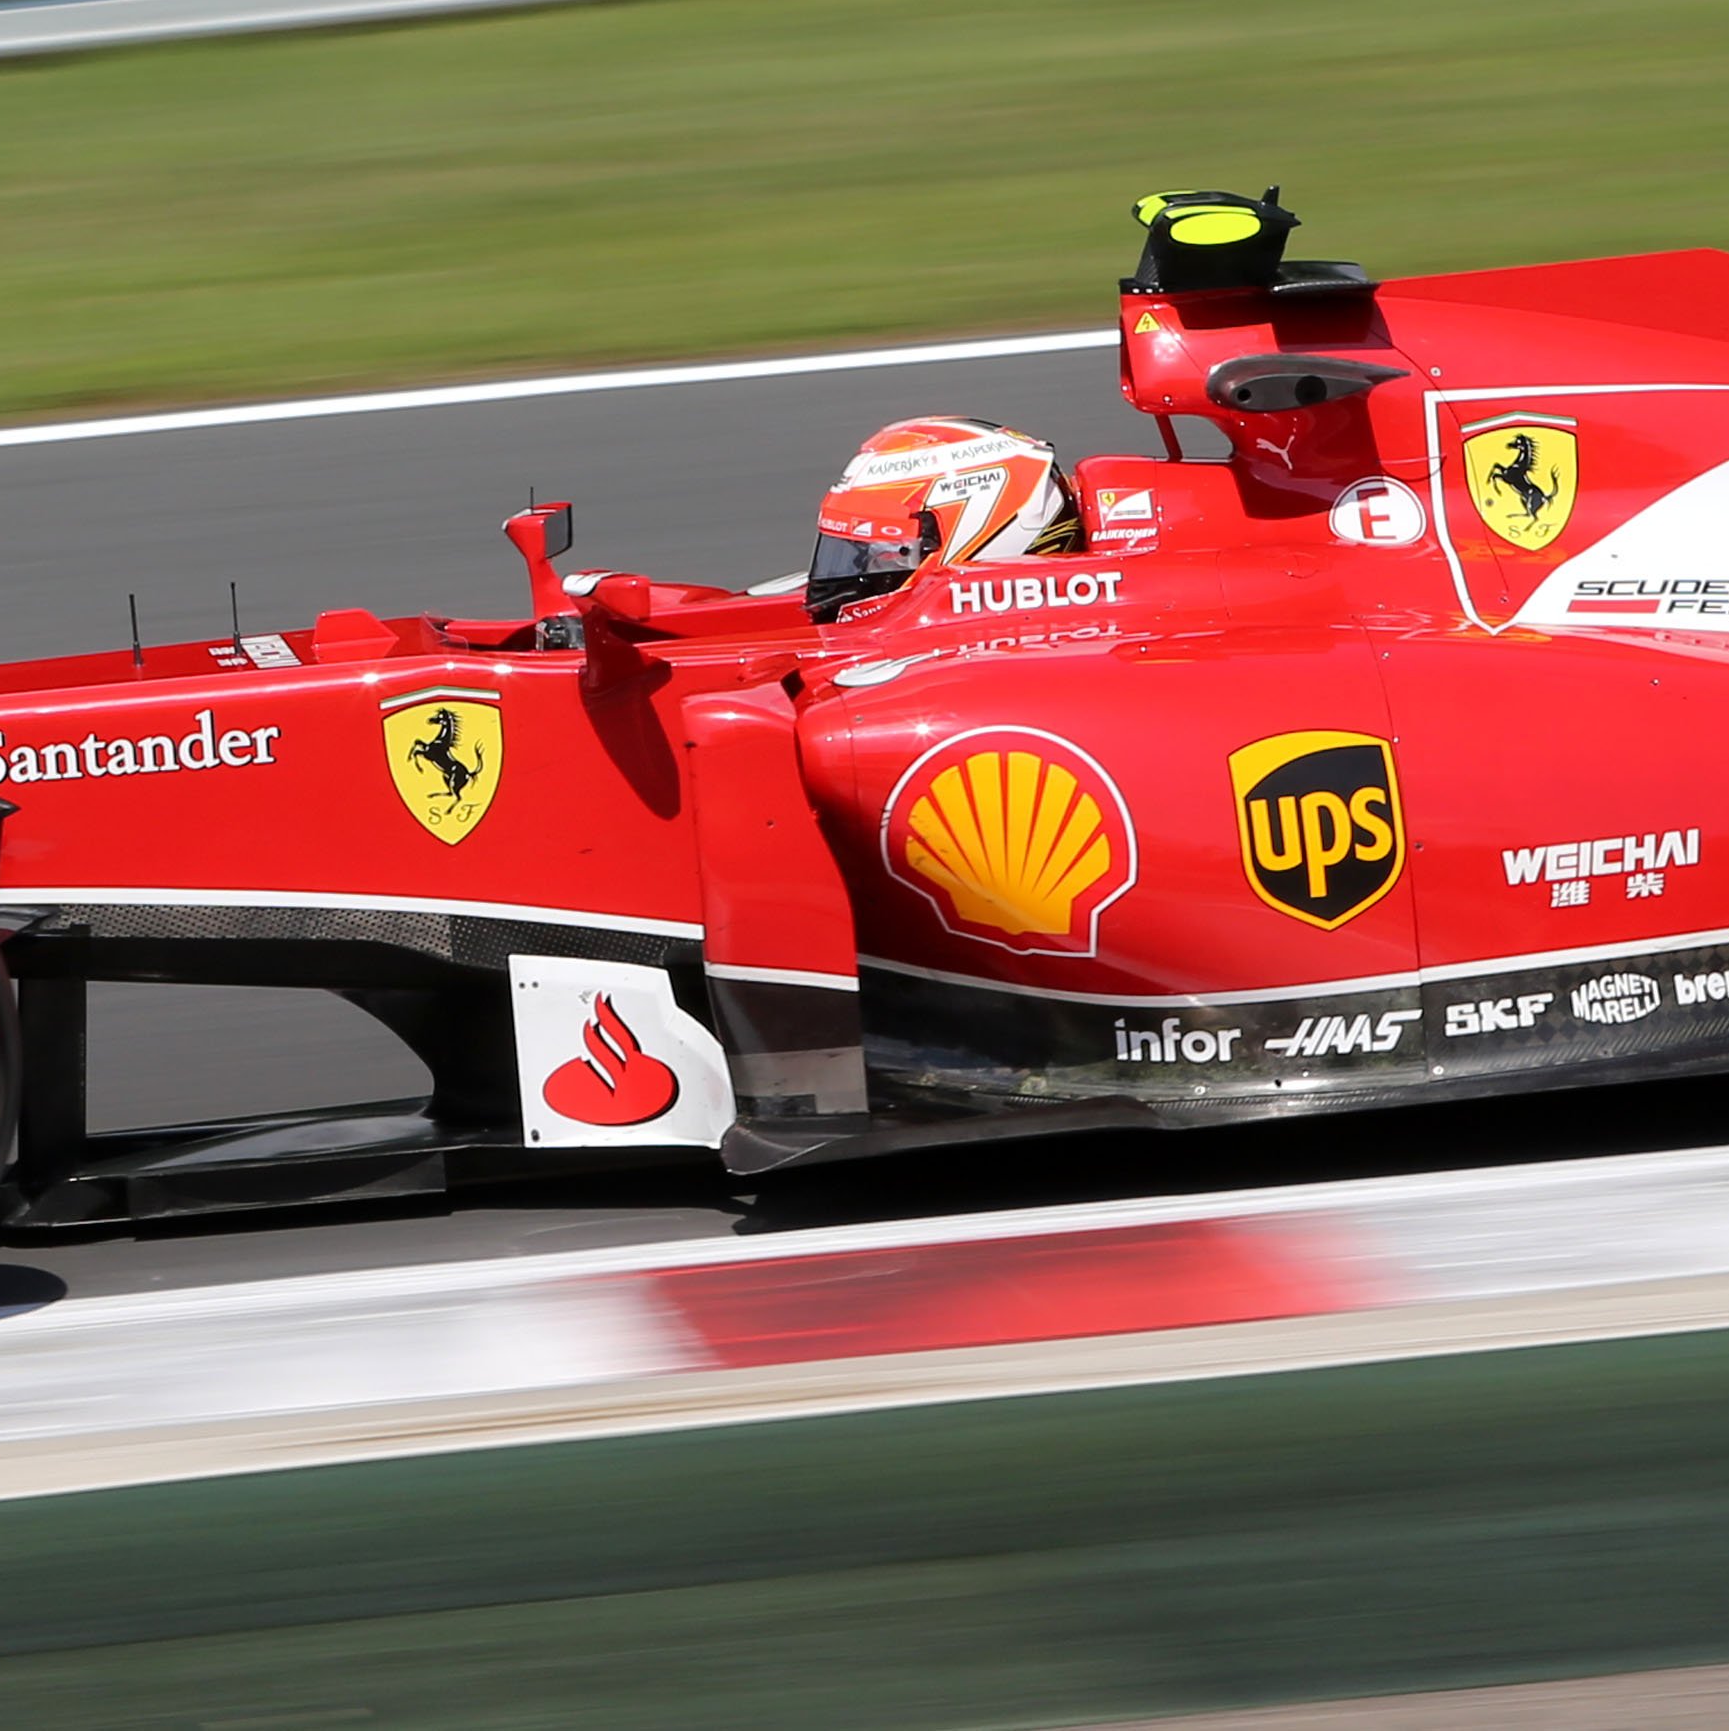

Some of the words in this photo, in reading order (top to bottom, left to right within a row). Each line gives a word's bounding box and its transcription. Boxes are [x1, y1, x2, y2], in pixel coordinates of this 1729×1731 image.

[949, 571, 1123, 615] HUBLOT
[1249, 786, 1394, 898] ups
[1502, 828, 1700, 886] WEICHAI
[1115, 1018, 1243, 1063] infor
[1264, 1009, 1424, 1057] HAAS
[1444, 992, 1554, 1037] SKF
